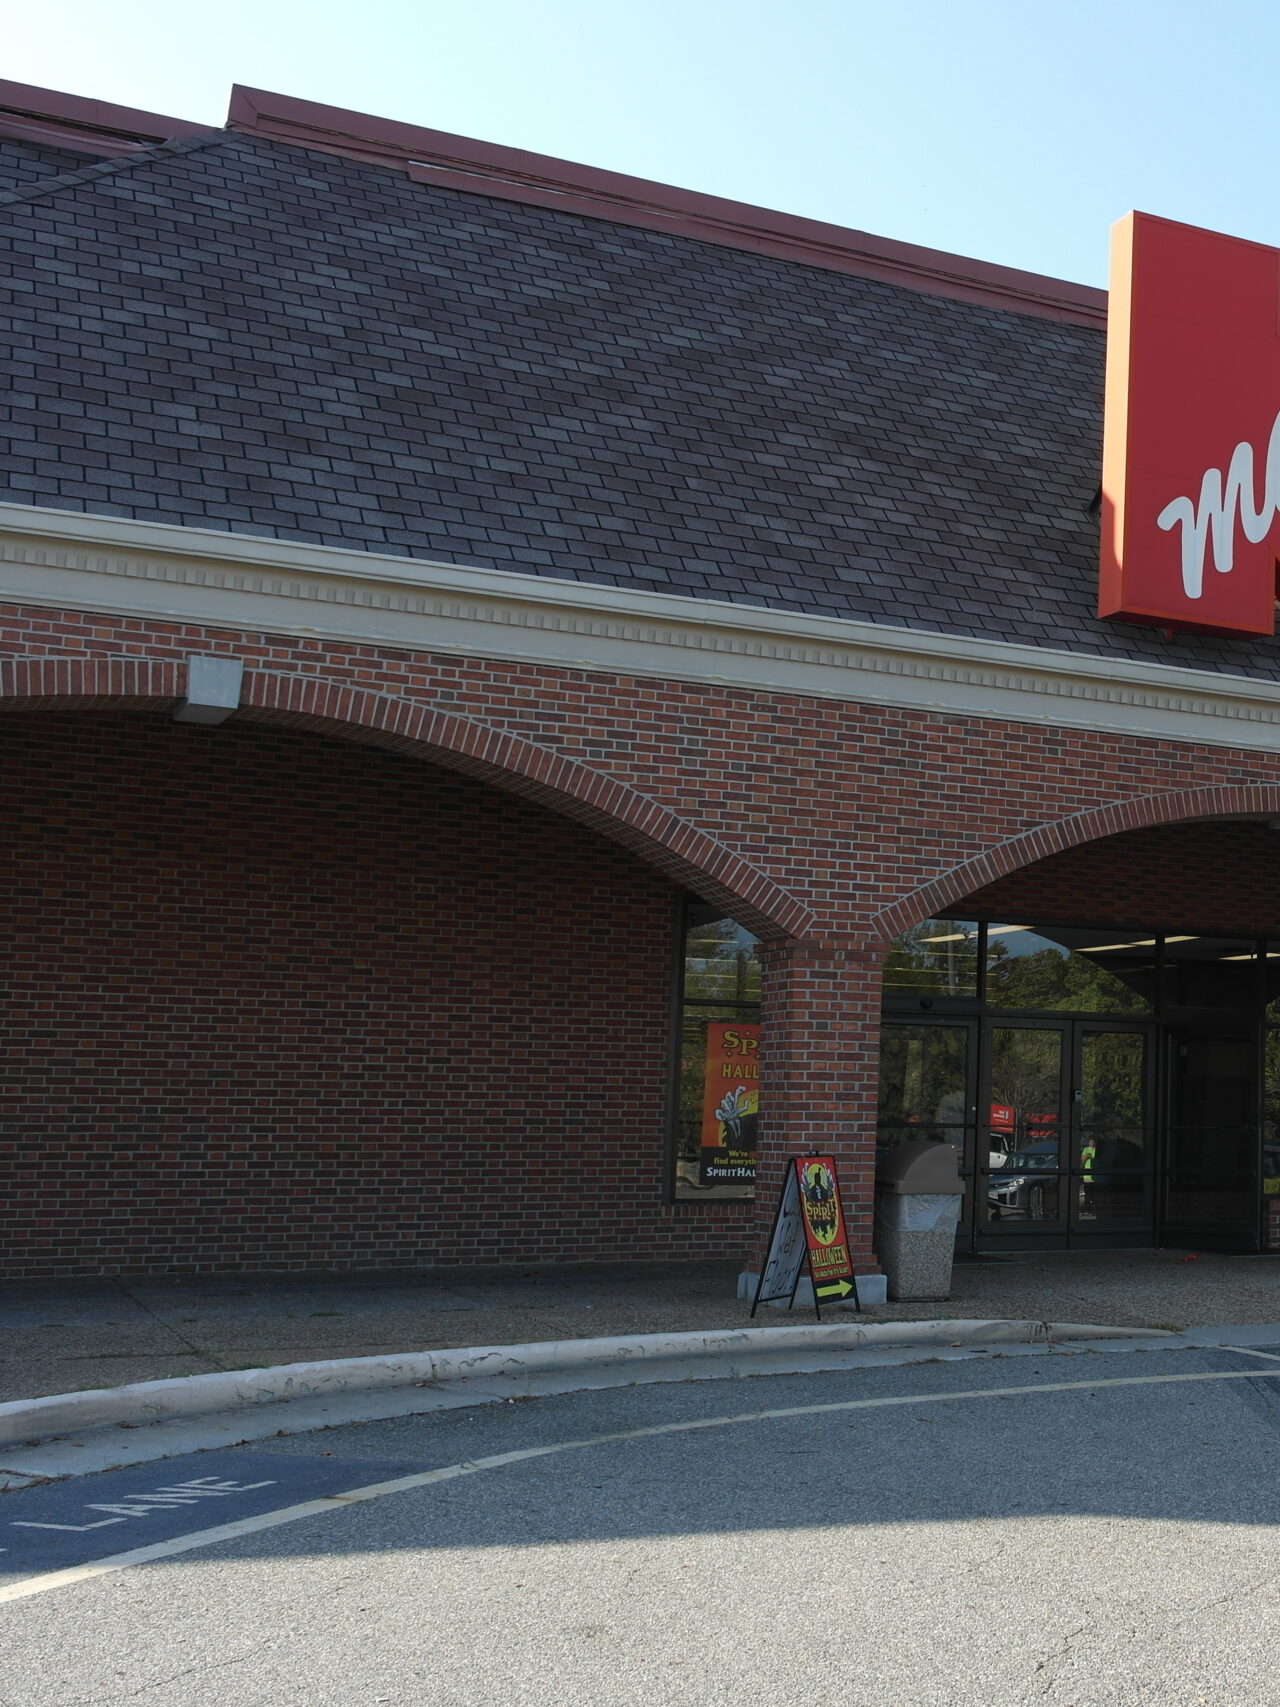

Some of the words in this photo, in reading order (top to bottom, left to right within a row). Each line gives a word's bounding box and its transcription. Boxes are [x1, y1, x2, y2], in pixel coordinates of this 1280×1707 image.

[807, 1198, 836, 1220] SPIRIT
[810, 1244, 848, 1268] HALLOWEEN
[9, 1476, 278, 1531] LANE
